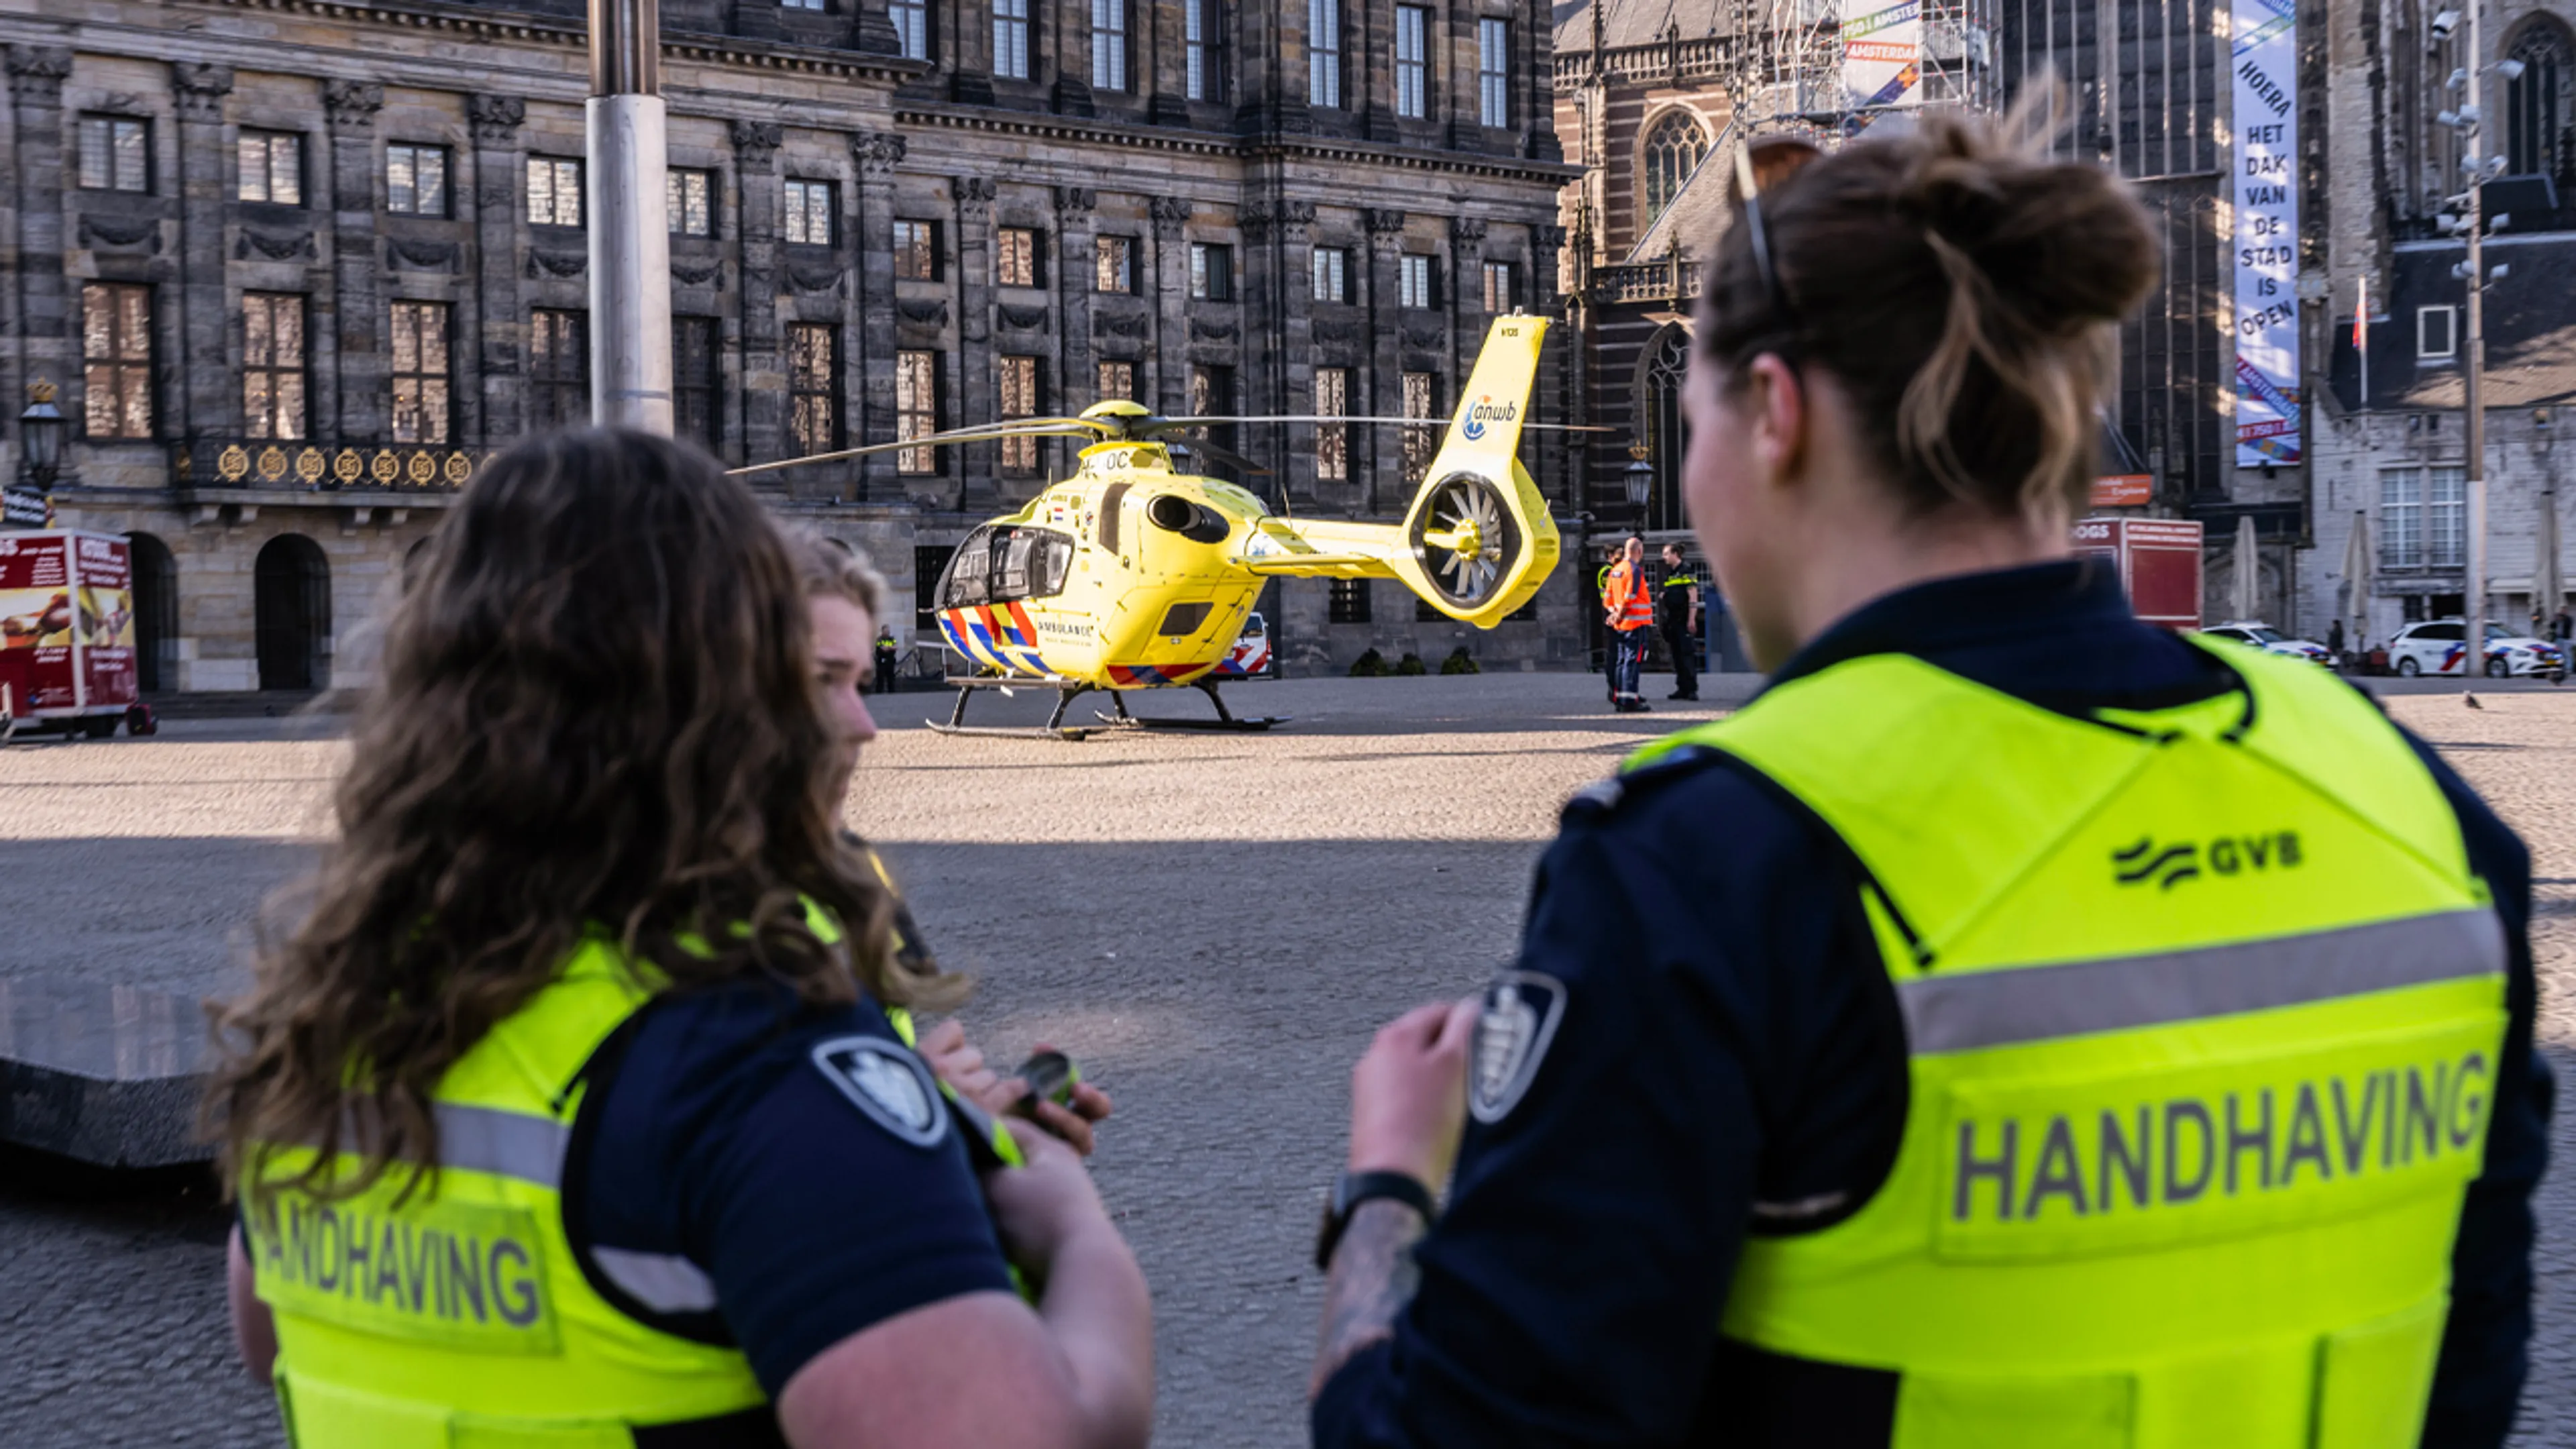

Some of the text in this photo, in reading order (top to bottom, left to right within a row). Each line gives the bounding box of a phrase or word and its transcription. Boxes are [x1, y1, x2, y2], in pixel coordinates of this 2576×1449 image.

[2237, 60, 2292, 118] HOERA
[2247, 123, 2284, 144] HET
[2246, 154, 2288, 176] DAK
[2245, 185, 2286, 205] VAN
[2254, 216, 2279, 235] DE
[2241, 246, 2292, 266] STAD
[2257, 277, 2277, 297] IS
[2241, 300, 2294, 335] OPEN
[1474, 401, 1516, 421] anwb
[1038, 621, 1091, 637] AMBULANCE
[2210, 833, 2302, 874] GVB
[1953, 1052, 2487, 1221] HANDHAVING
[254, 1201, 539, 1326] ANDHAVING
